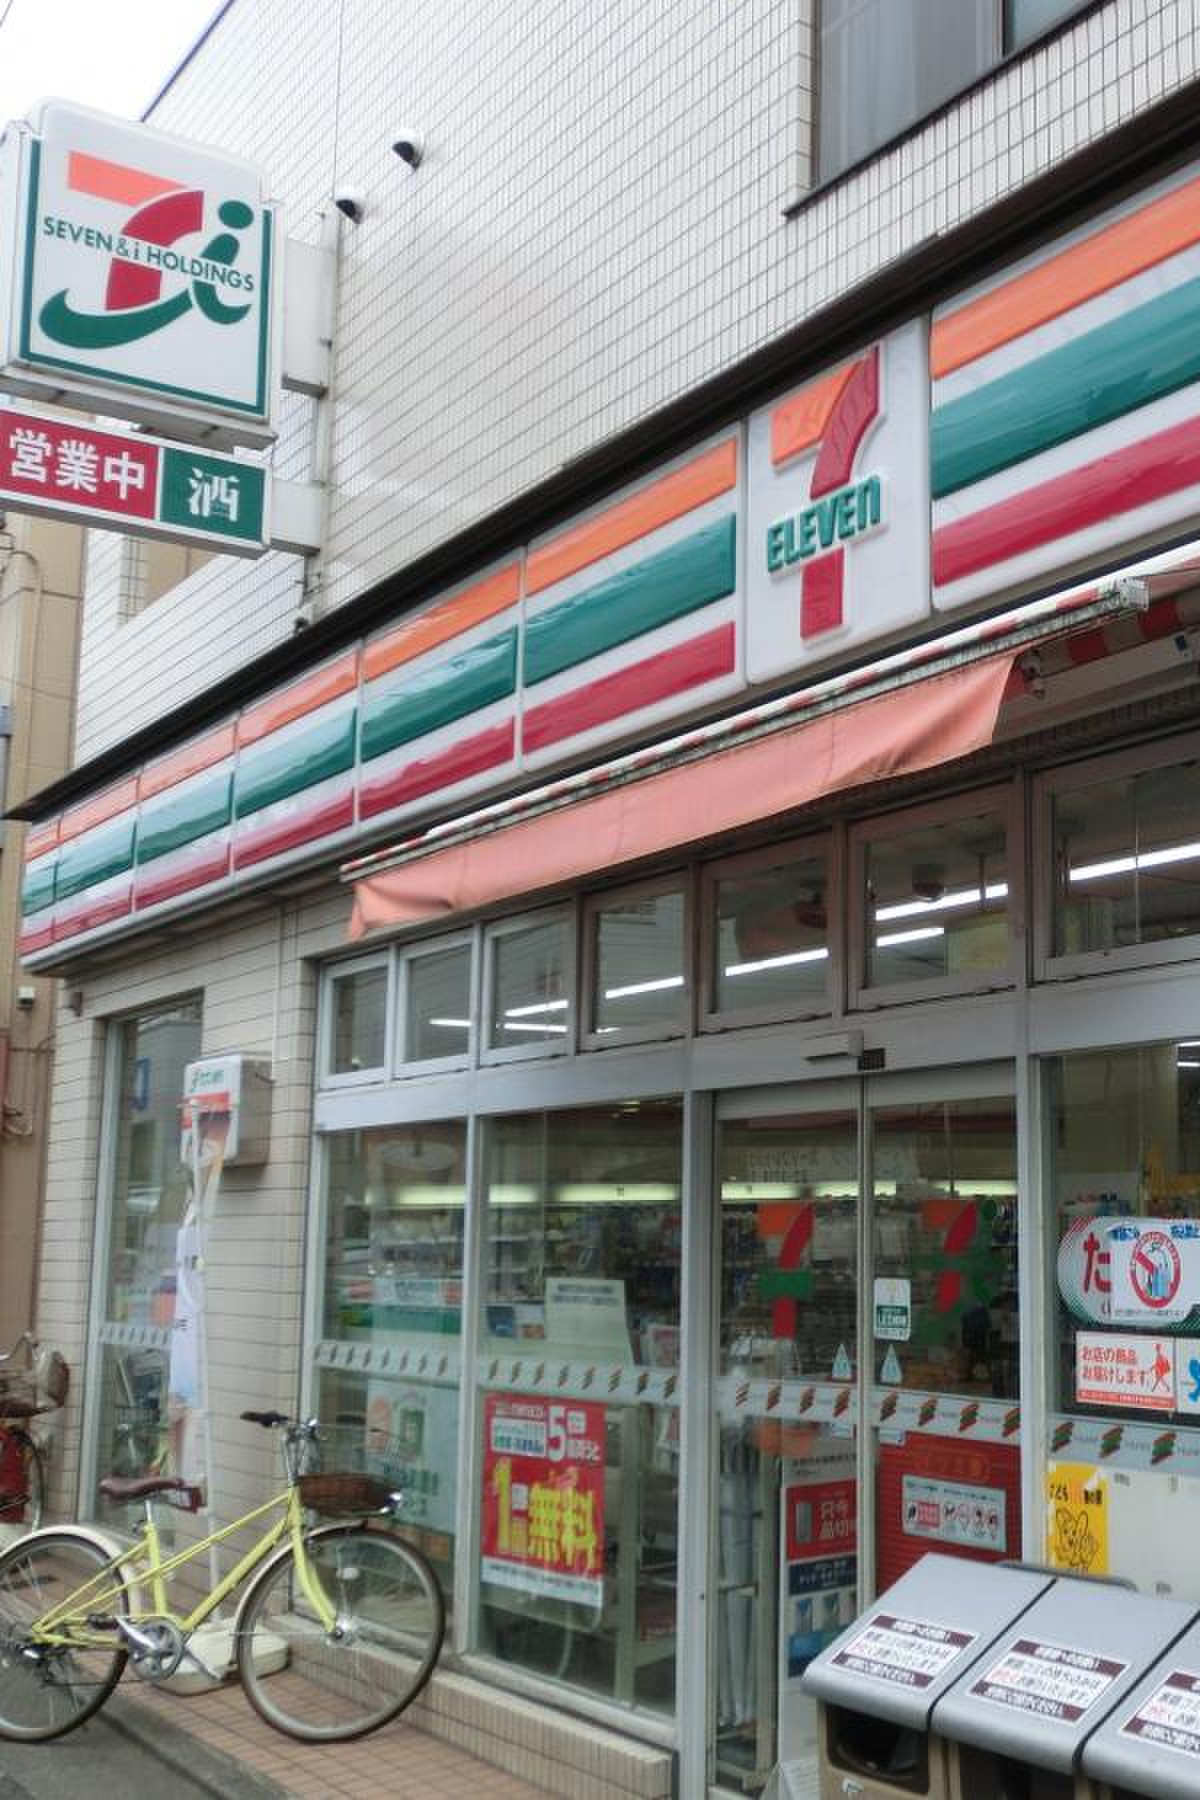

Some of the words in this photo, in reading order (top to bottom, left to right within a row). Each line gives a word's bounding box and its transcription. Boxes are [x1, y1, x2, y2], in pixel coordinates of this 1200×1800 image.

[147, 244, 255, 291] HOLDINGS
[9, 428, 146, 501] 営業中
[188, 466, 240, 522] 酒
